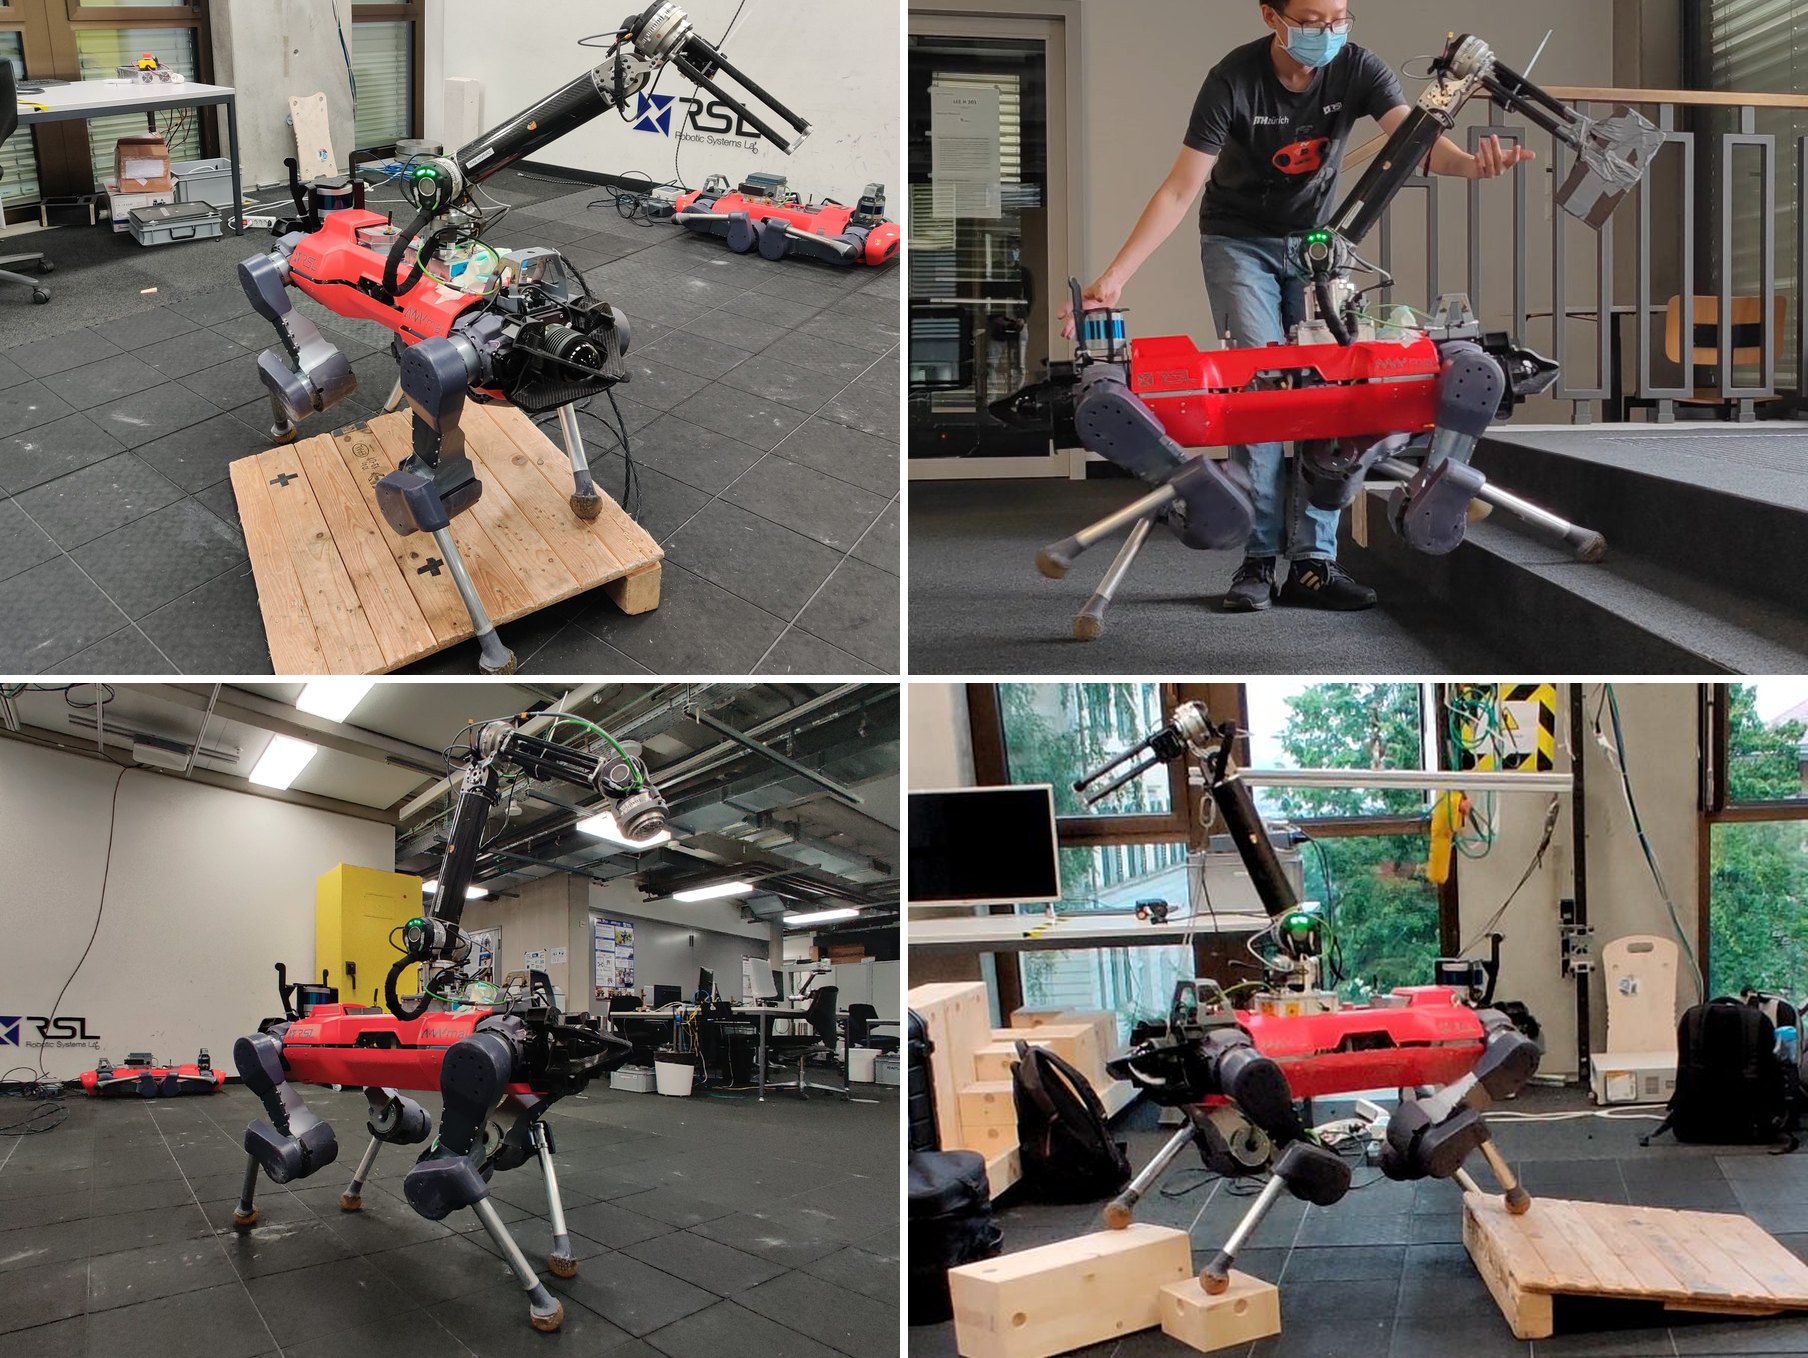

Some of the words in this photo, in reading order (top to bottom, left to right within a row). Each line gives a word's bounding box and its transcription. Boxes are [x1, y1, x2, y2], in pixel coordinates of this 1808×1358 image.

[679, 96, 761, 138] RSL
[675, 131, 705, 143] Robotic
[706, 135, 742, 149] Systems
[403, 306, 443, 335] ANYma
[26, 1016, 101, 1040] RSL
